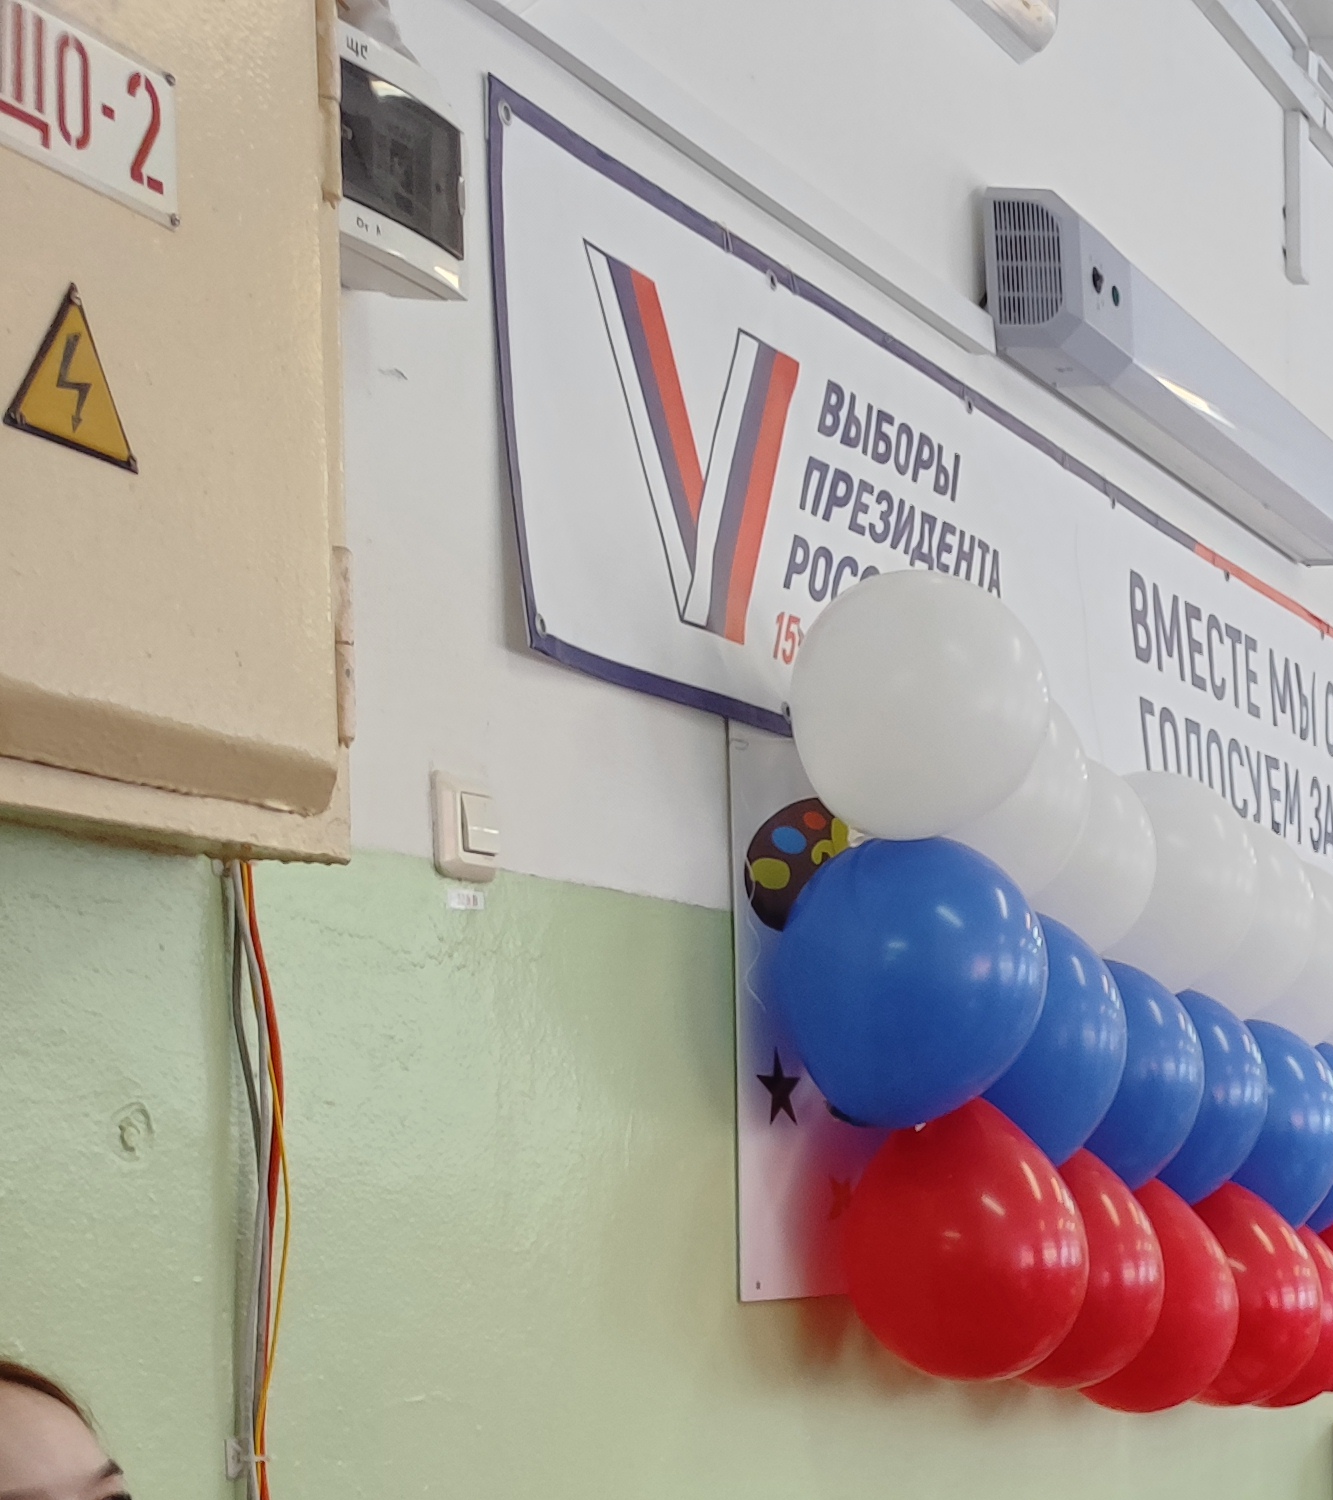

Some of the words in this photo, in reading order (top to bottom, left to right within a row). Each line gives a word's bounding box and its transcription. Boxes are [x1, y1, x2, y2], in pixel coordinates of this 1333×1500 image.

[817, 379, 961, 503] ВЫБОРЫ
[783, 533, 880, 602] РОС
[799, 455, 1001, 600] ПРЕЗИДЕНТА
[1129, 568, 1261, 719] ВМЕСТЕ
[1269, 647, 1318, 747] МЫ
[1139, 695, 1302, 845] ГОЛОСУЕМ
